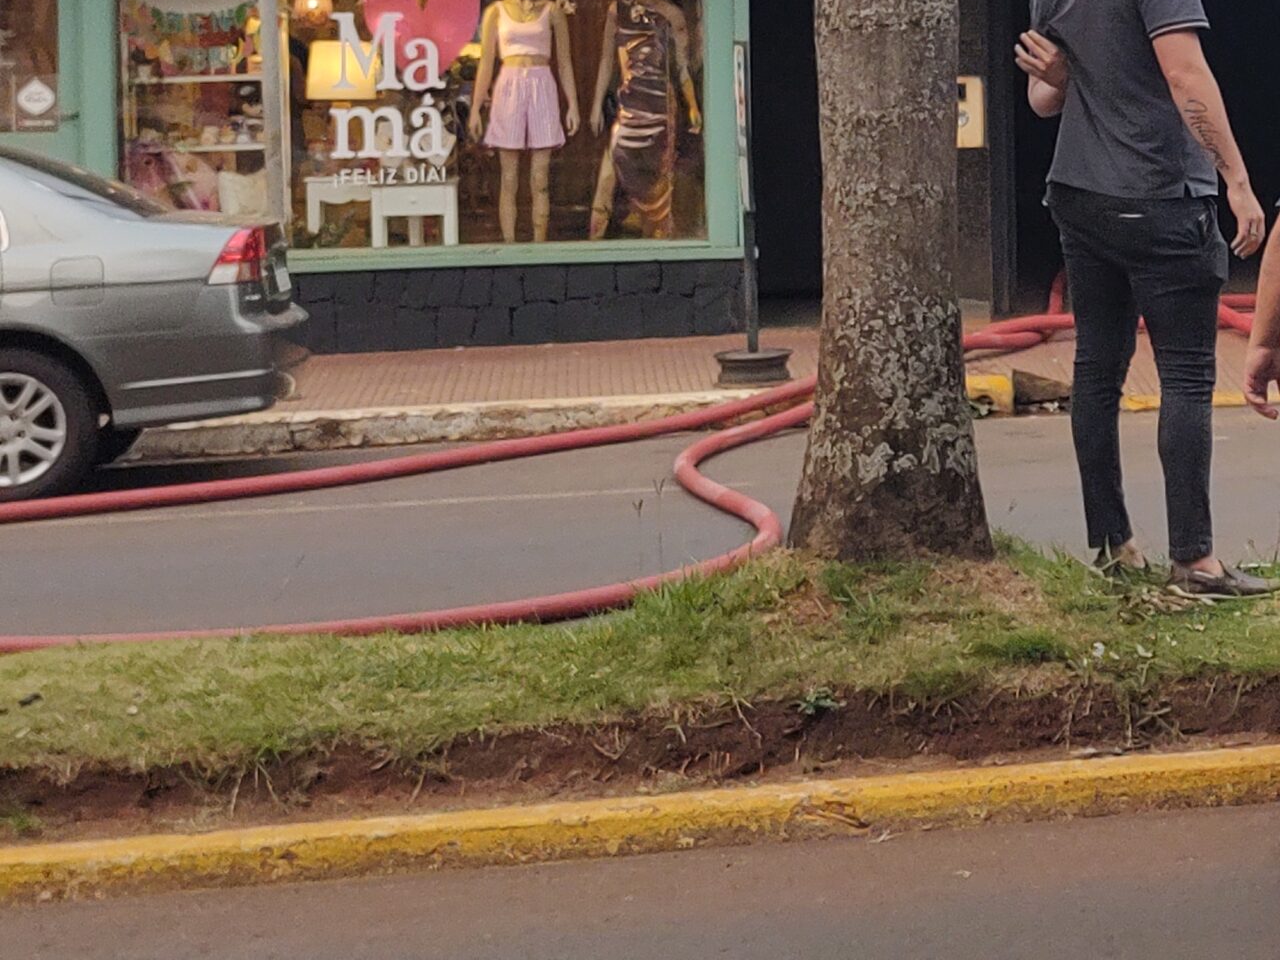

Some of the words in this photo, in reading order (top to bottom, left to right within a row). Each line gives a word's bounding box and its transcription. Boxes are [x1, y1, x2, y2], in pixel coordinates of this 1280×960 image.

[330, 11, 447, 91] Ma
[329, 92, 450, 159] má
[406, 162, 447, 184] DÍA!
